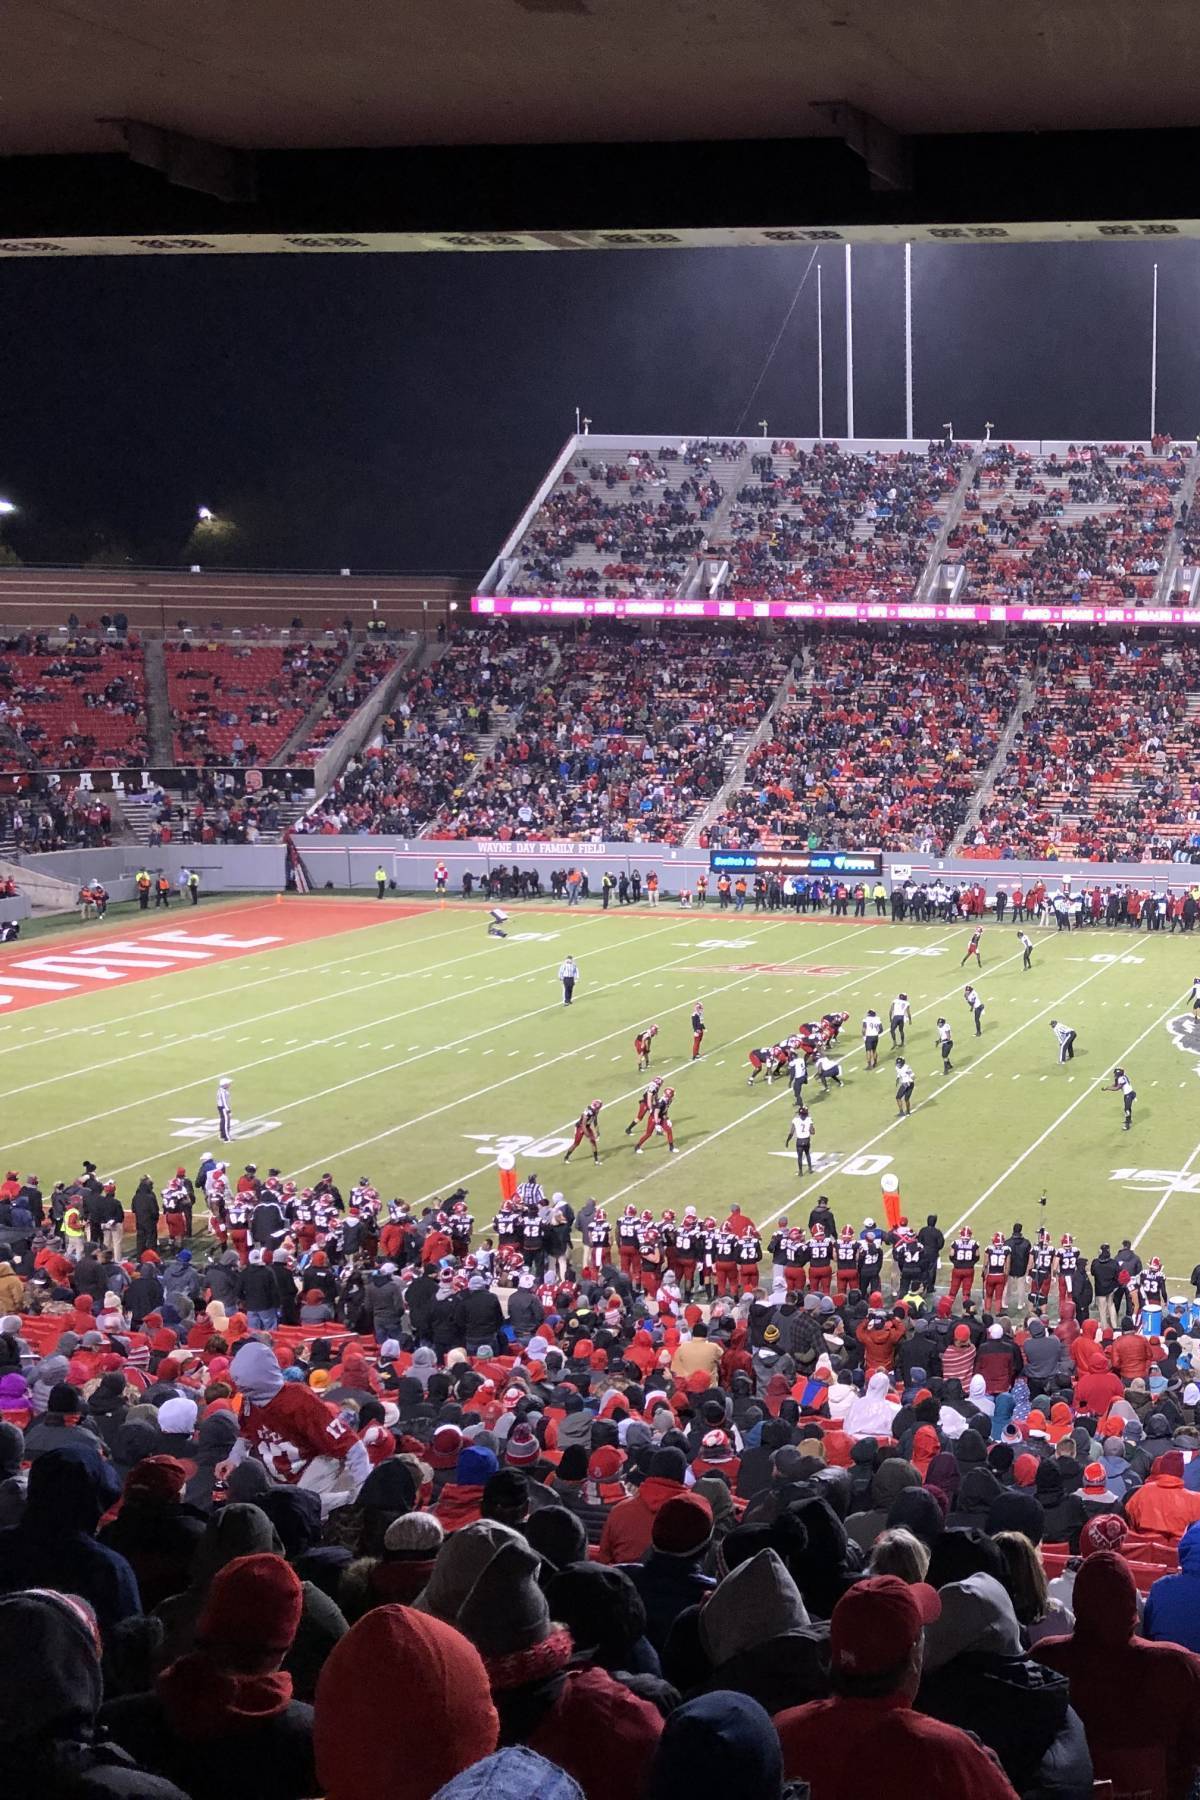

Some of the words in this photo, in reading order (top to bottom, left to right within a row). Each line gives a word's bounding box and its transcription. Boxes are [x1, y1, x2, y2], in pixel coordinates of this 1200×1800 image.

[478, 842, 513, 852] WAYNE
[517, 842, 537, 853] DAY
[540, 842, 575, 854] FAMILY
[579, 843, 606, 854] FIELD
[714, 857, 744, 867] Switch
[746, 857, 756, 867] to
[811, 858, 831, 868] with
[889, 946, 950, 956] 30
[1089, 953, 1146, 965] 40
[475, 1135, 575, 1158] 30
[523, 1226, 539, 1237] 42
[591, 1231, 606, 1242] 27
[620, 1225, 634, 1237] 65
[716, 1243, 732, 1255] 75
[741, 1248, 756, 1259] 43
[812, 1247, 828, 1259] 93
[839, 1249, 854, 1260] 52
[904, 1252, 919, 1263] 34
[1062, 1258, 1076, 1269] 33
[1144, 1280, 1158, 1293] 33
[326, 1419, 346, 1440] 17
